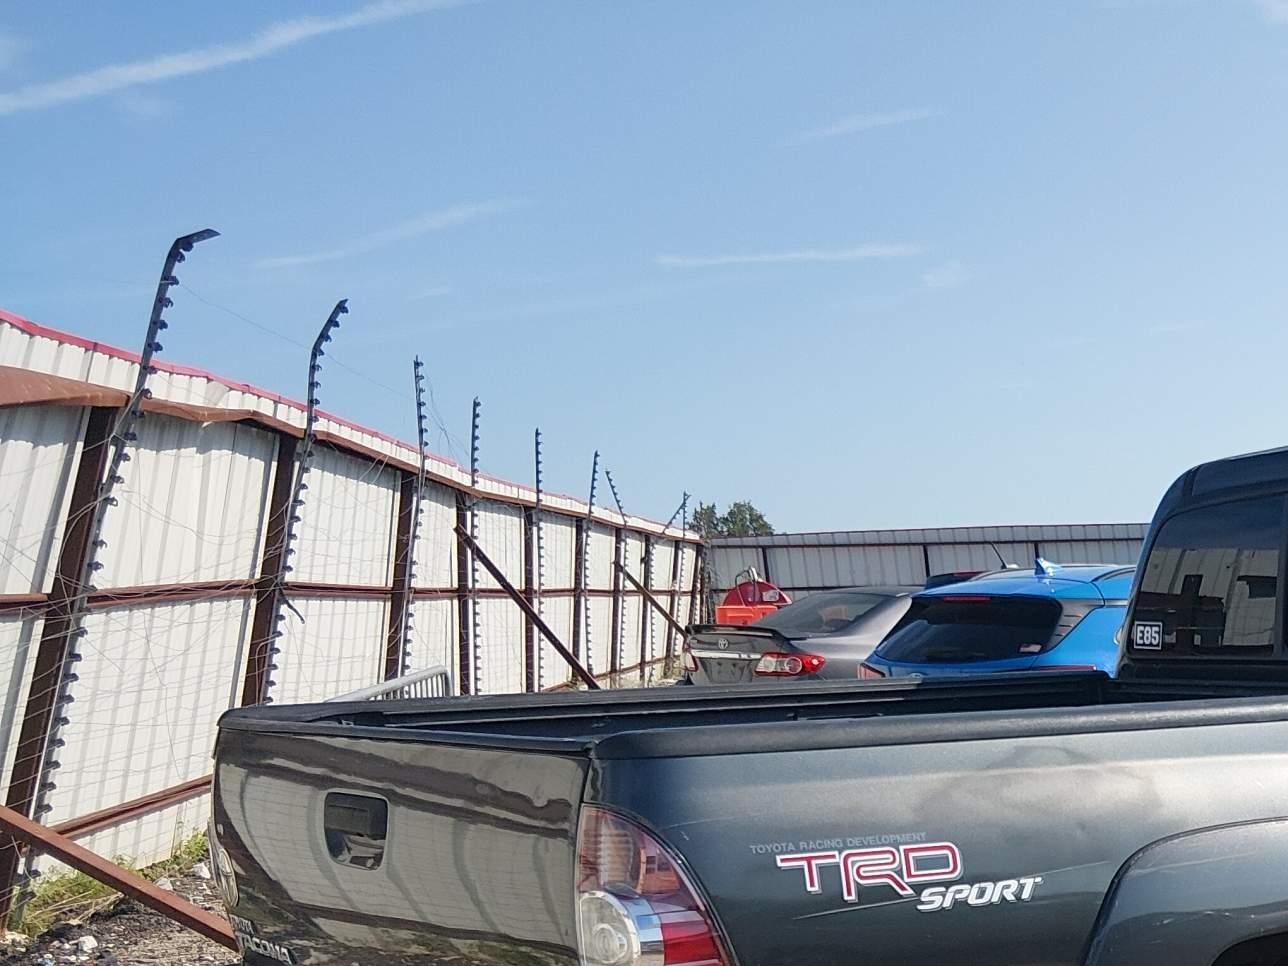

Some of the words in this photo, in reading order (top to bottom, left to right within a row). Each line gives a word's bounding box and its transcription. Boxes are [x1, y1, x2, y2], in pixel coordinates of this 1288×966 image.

[1136, 625, 1160, 645] E85
[750, 841, 797, 855] TOYOTA
[800, 837, 844, 850] RACING
[847, 831, 927, 847] DEVELOPMENT
[775, 841, 964, 903] TRD
[915, 877, 1045, 913] SPORT
[235, 931, 293, 966] TACOMA
